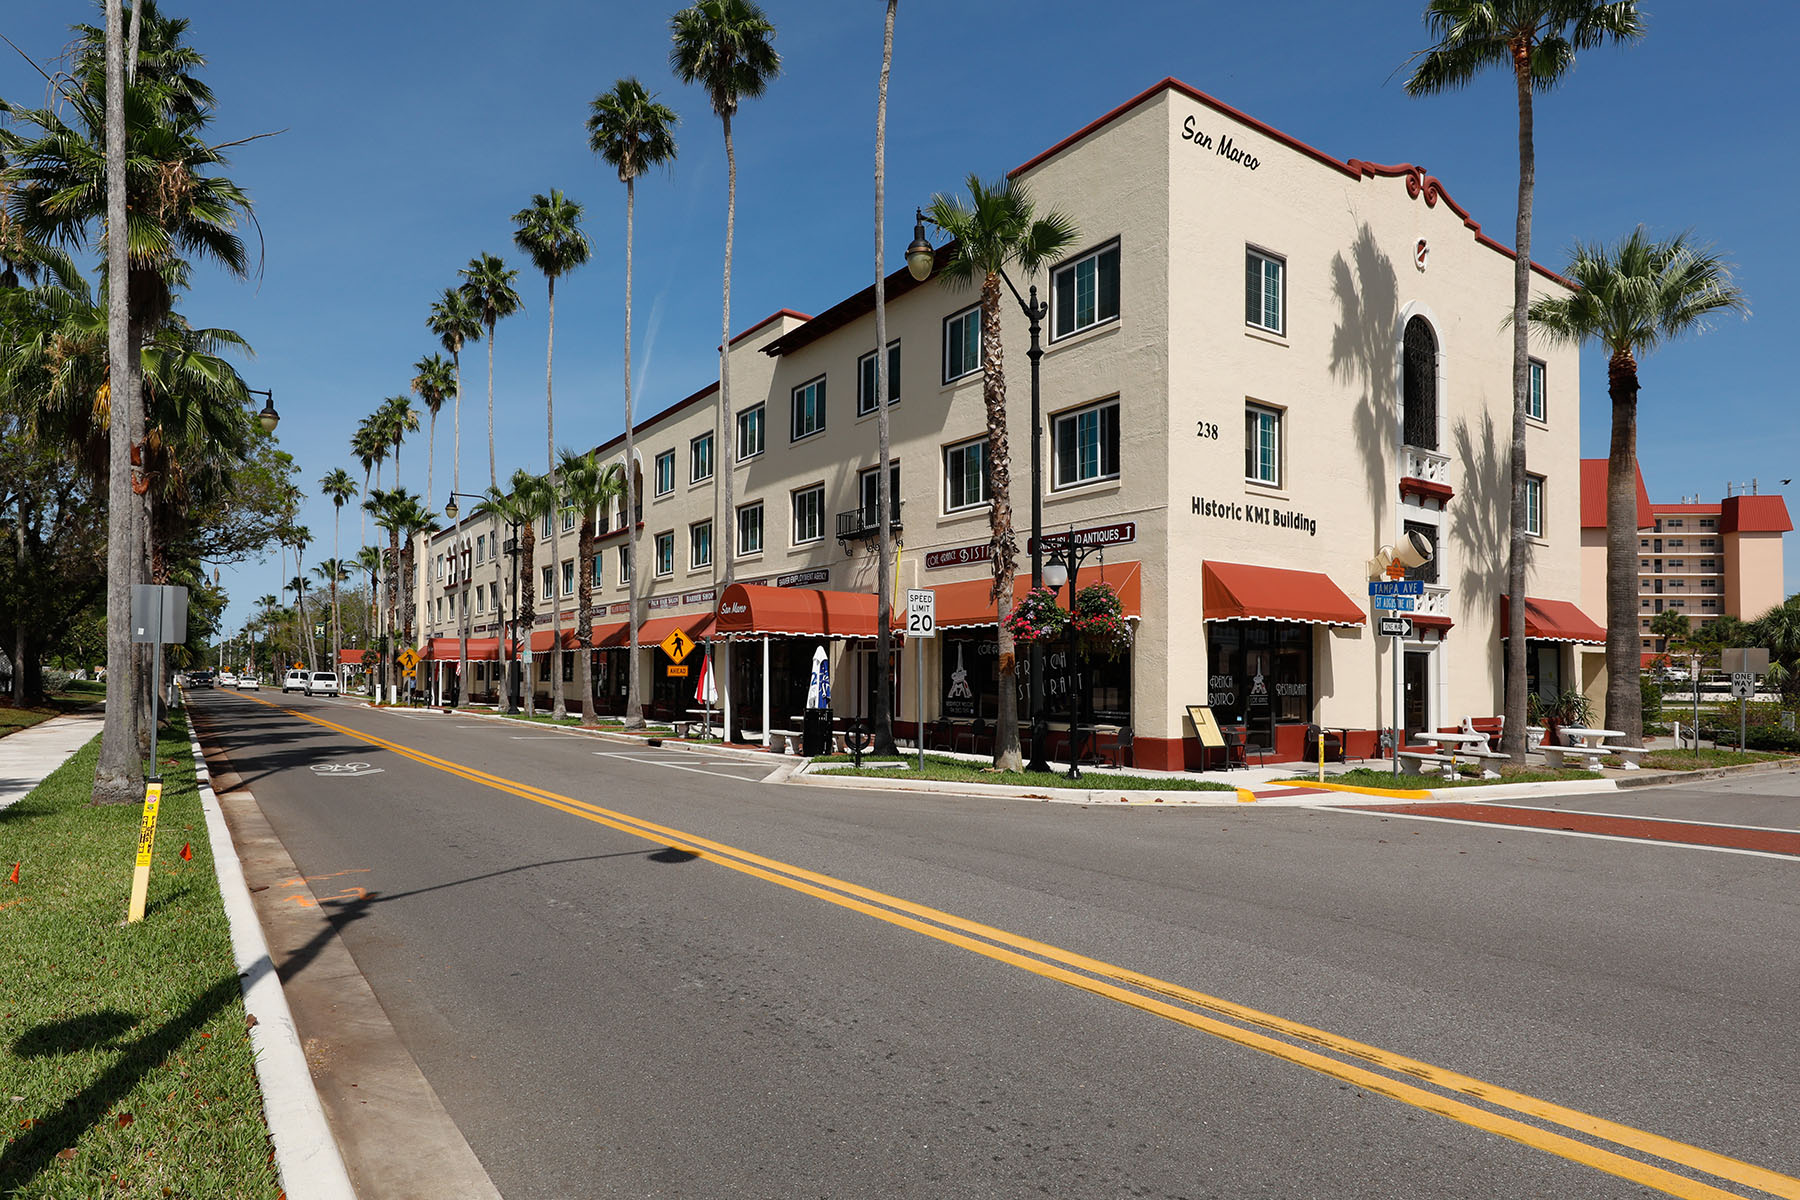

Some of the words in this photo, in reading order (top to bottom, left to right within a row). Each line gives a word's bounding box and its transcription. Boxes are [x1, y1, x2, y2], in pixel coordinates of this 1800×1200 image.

[1182, 115, 1212, 150] San
[1216, 135, 1261, 171] Marco
[1196, 421, 1218, 440] 238
[1192, 496, 1242, 521] Historic
[1246, 505, 1270, 525] KMI
[1273, 509, 1316, 536] Building
[1083, 529, 1119, 544] ANTIQUES
[1374, 583, 1399, 594] TAMPA
[1402, 583, 1418, 593] AVE
[910, 594, 932, 603] SPEED
[1383, 598, 1405, 609] AUGUSINE
[721, 602, 732, 615] San
[910, 614, 932, 631] 20
[1208, 692, 1235, 707] BISTRO
